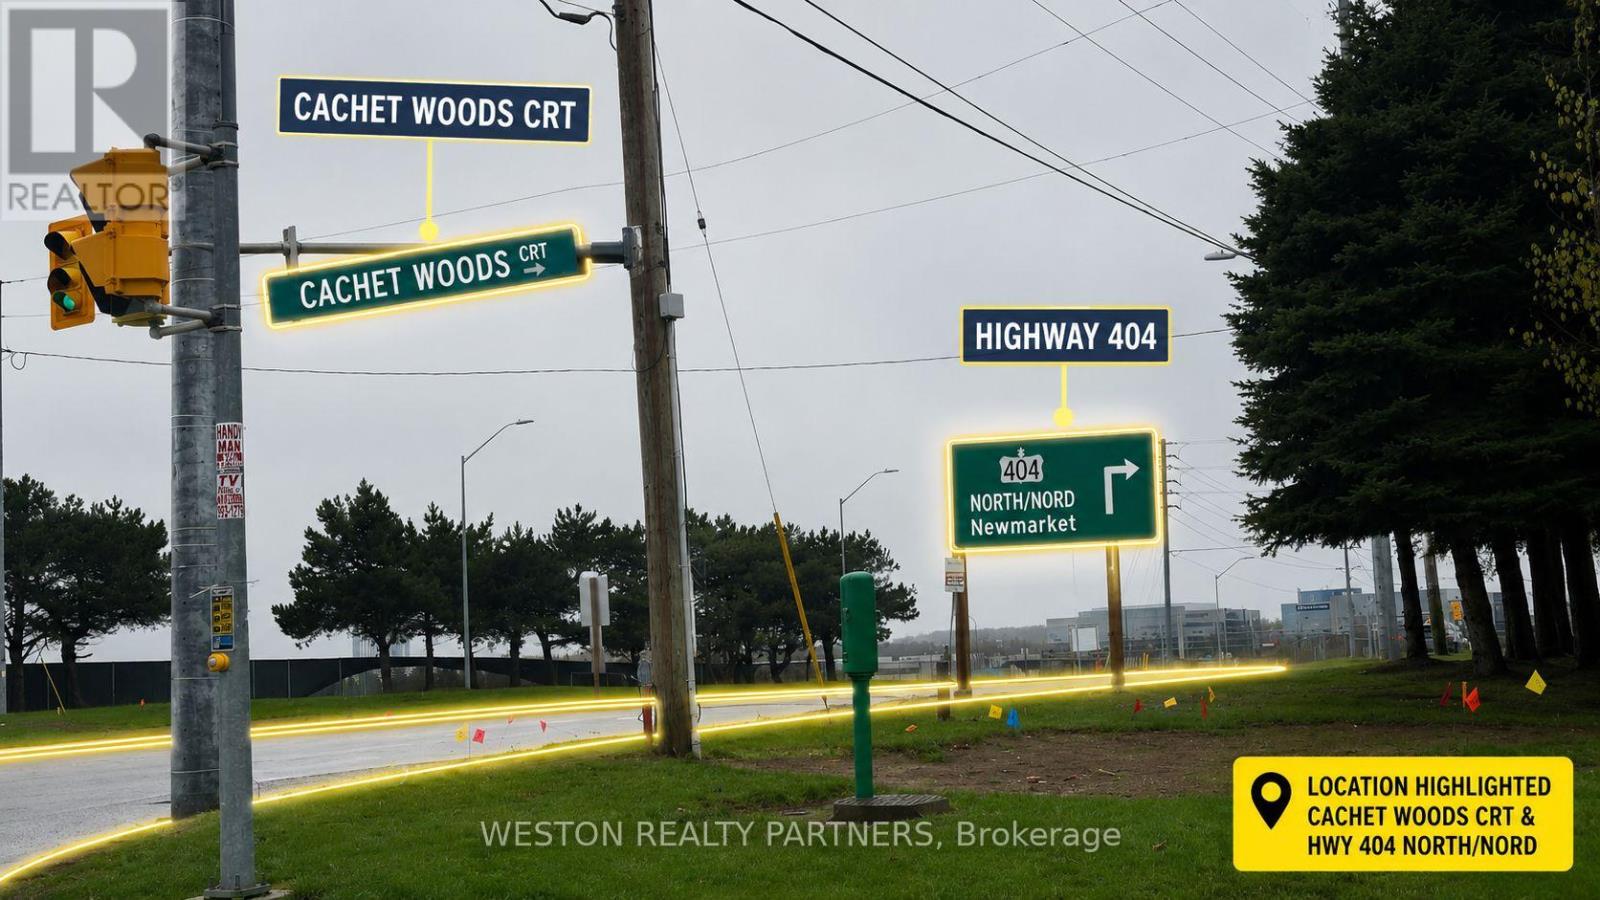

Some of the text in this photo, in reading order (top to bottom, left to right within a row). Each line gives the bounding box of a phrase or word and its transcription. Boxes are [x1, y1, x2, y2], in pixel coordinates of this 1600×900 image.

[518, 242, 548, 262] CRT
[300, 249, 511, 309] CACHET WOODS
[216, 424, 241, 440] HANDY
[218, 440, 241, 453] MAN
[1003, 459, 1040, 481] 404
[219, 475, 239, 487] TV
[970, 490, 1075, 512] NORTH/NORD
[971, 514, 1076, 536] Newmarket
